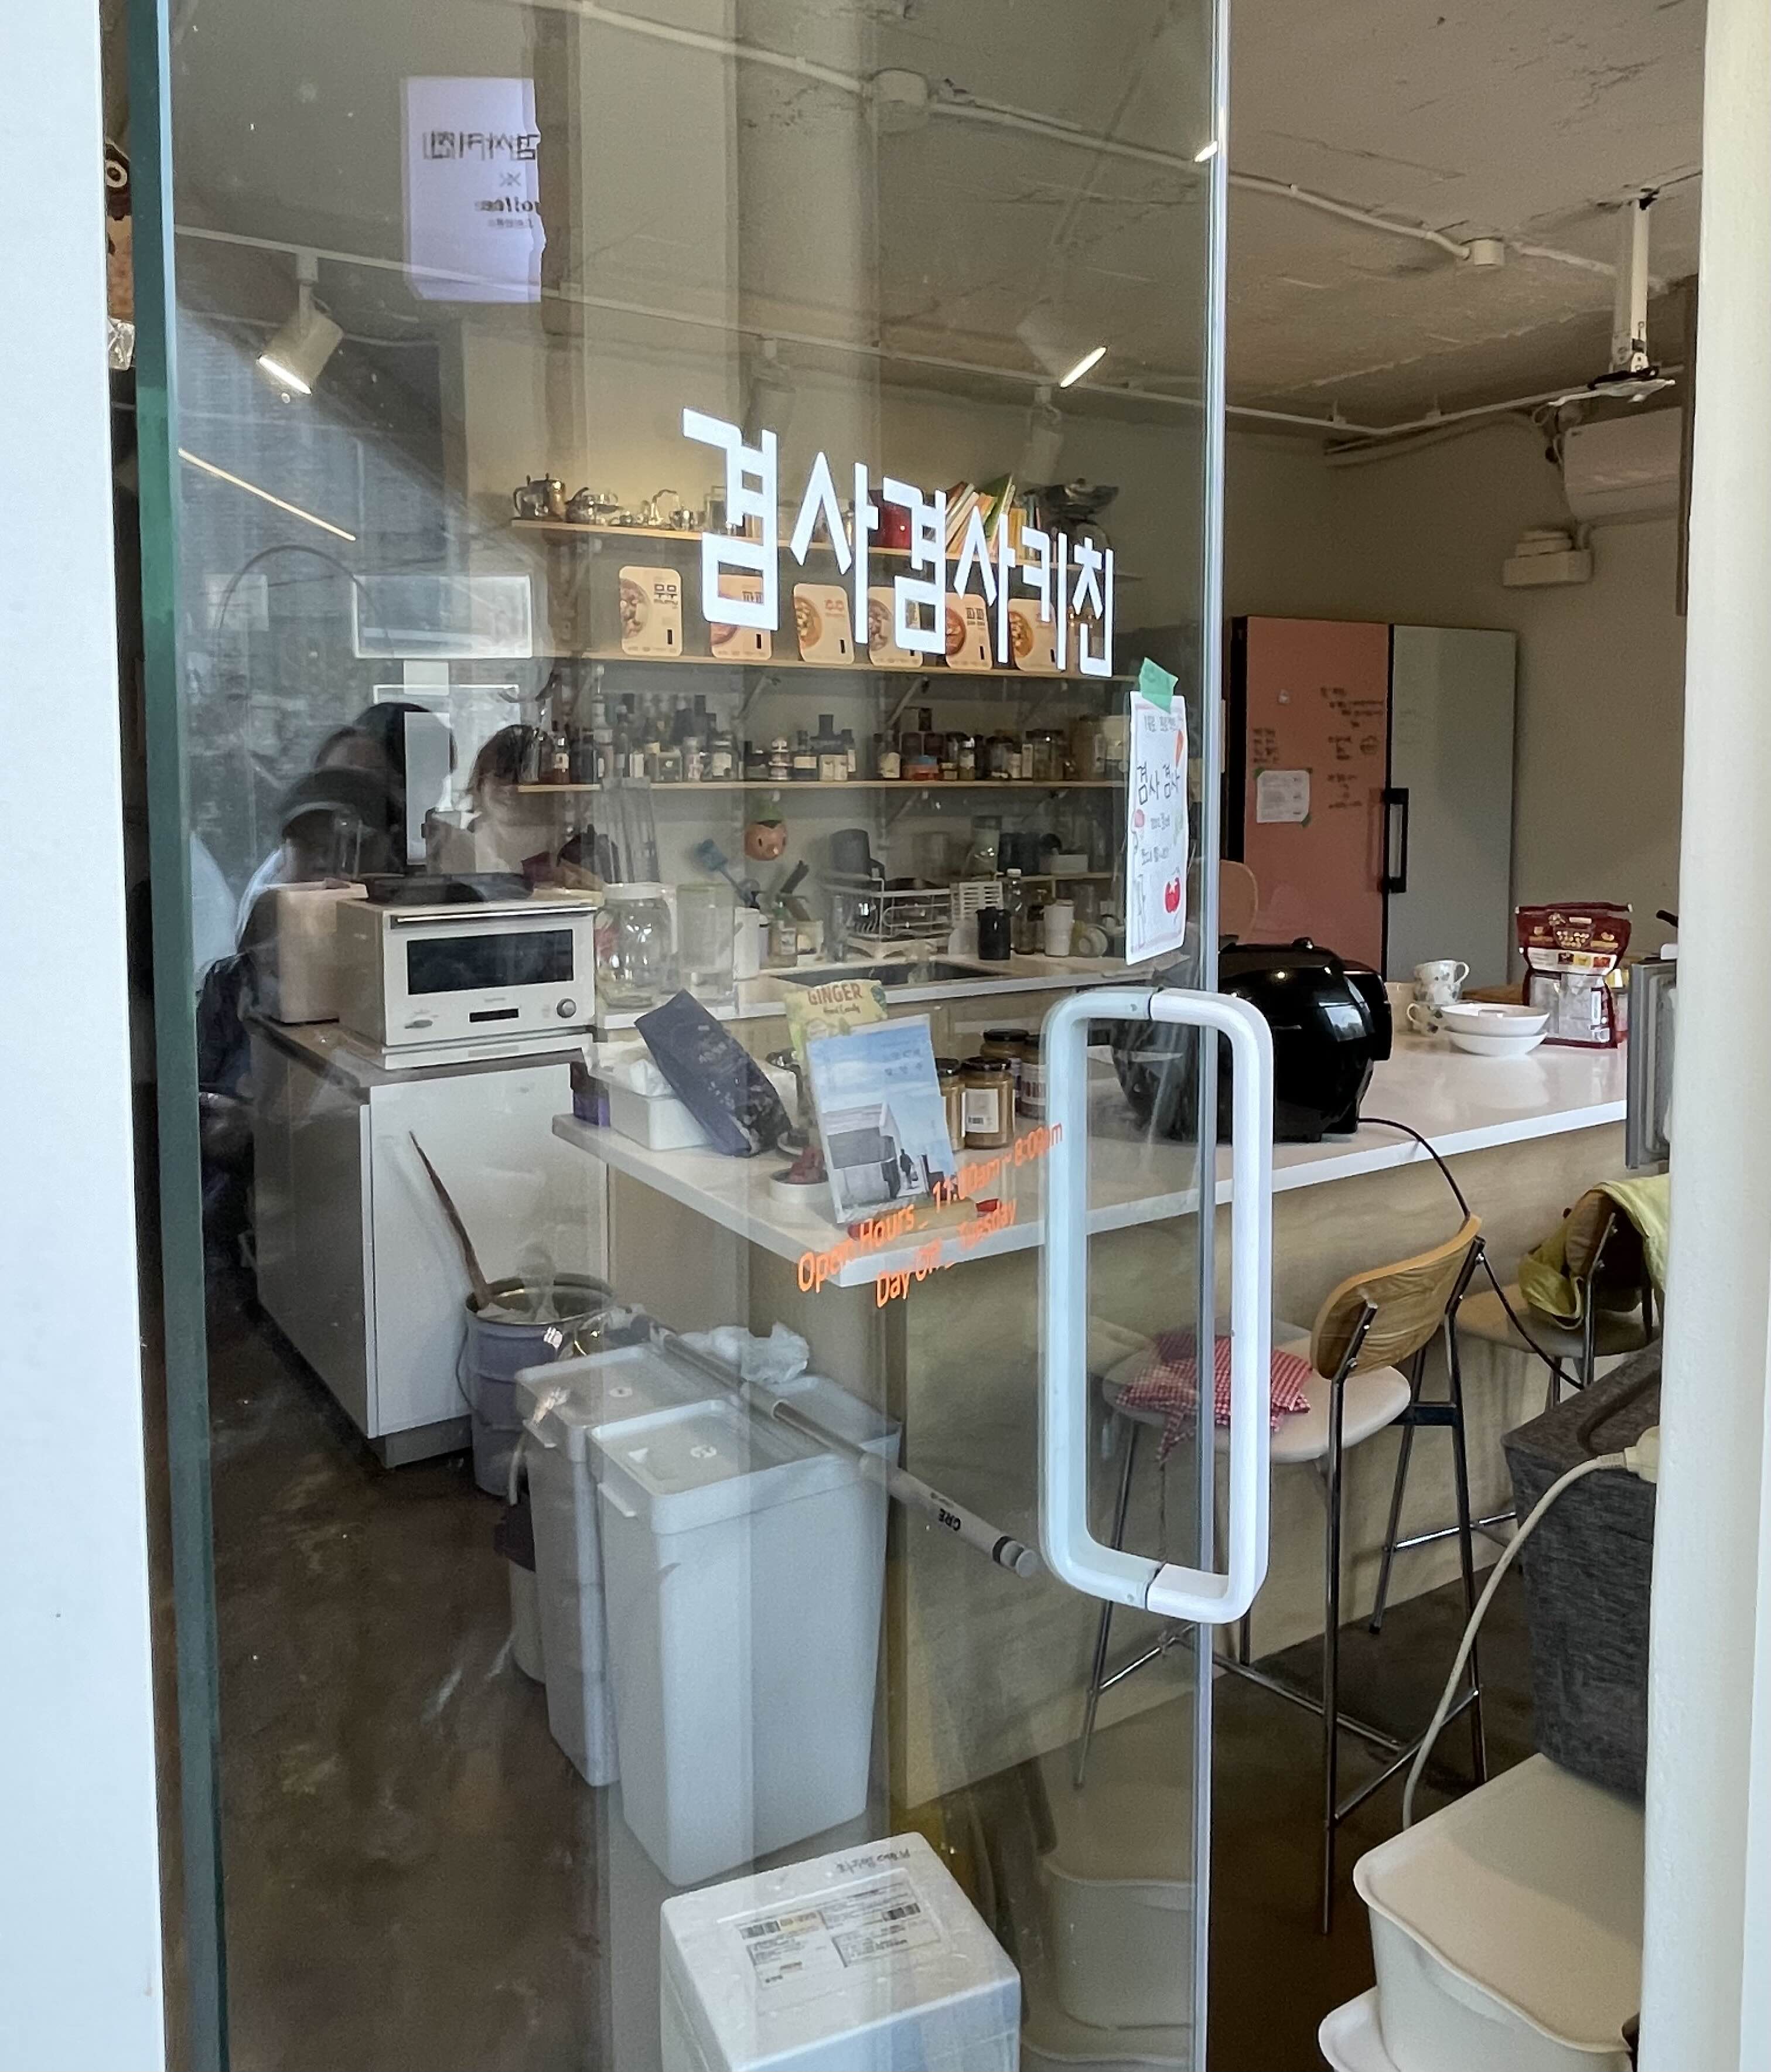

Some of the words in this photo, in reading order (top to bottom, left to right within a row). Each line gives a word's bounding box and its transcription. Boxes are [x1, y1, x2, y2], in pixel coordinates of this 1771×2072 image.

[682, 408, 1115, 678] 겸사겸사키친
[807, 982, 863, 1006] GINGER
[798, 1236, 854, 1293] Open
[859, 1203, 914, 1252] Hours
[876, 1268, 910, 1308] Day
[957, 1198, 1017, 1254] Tuesday
